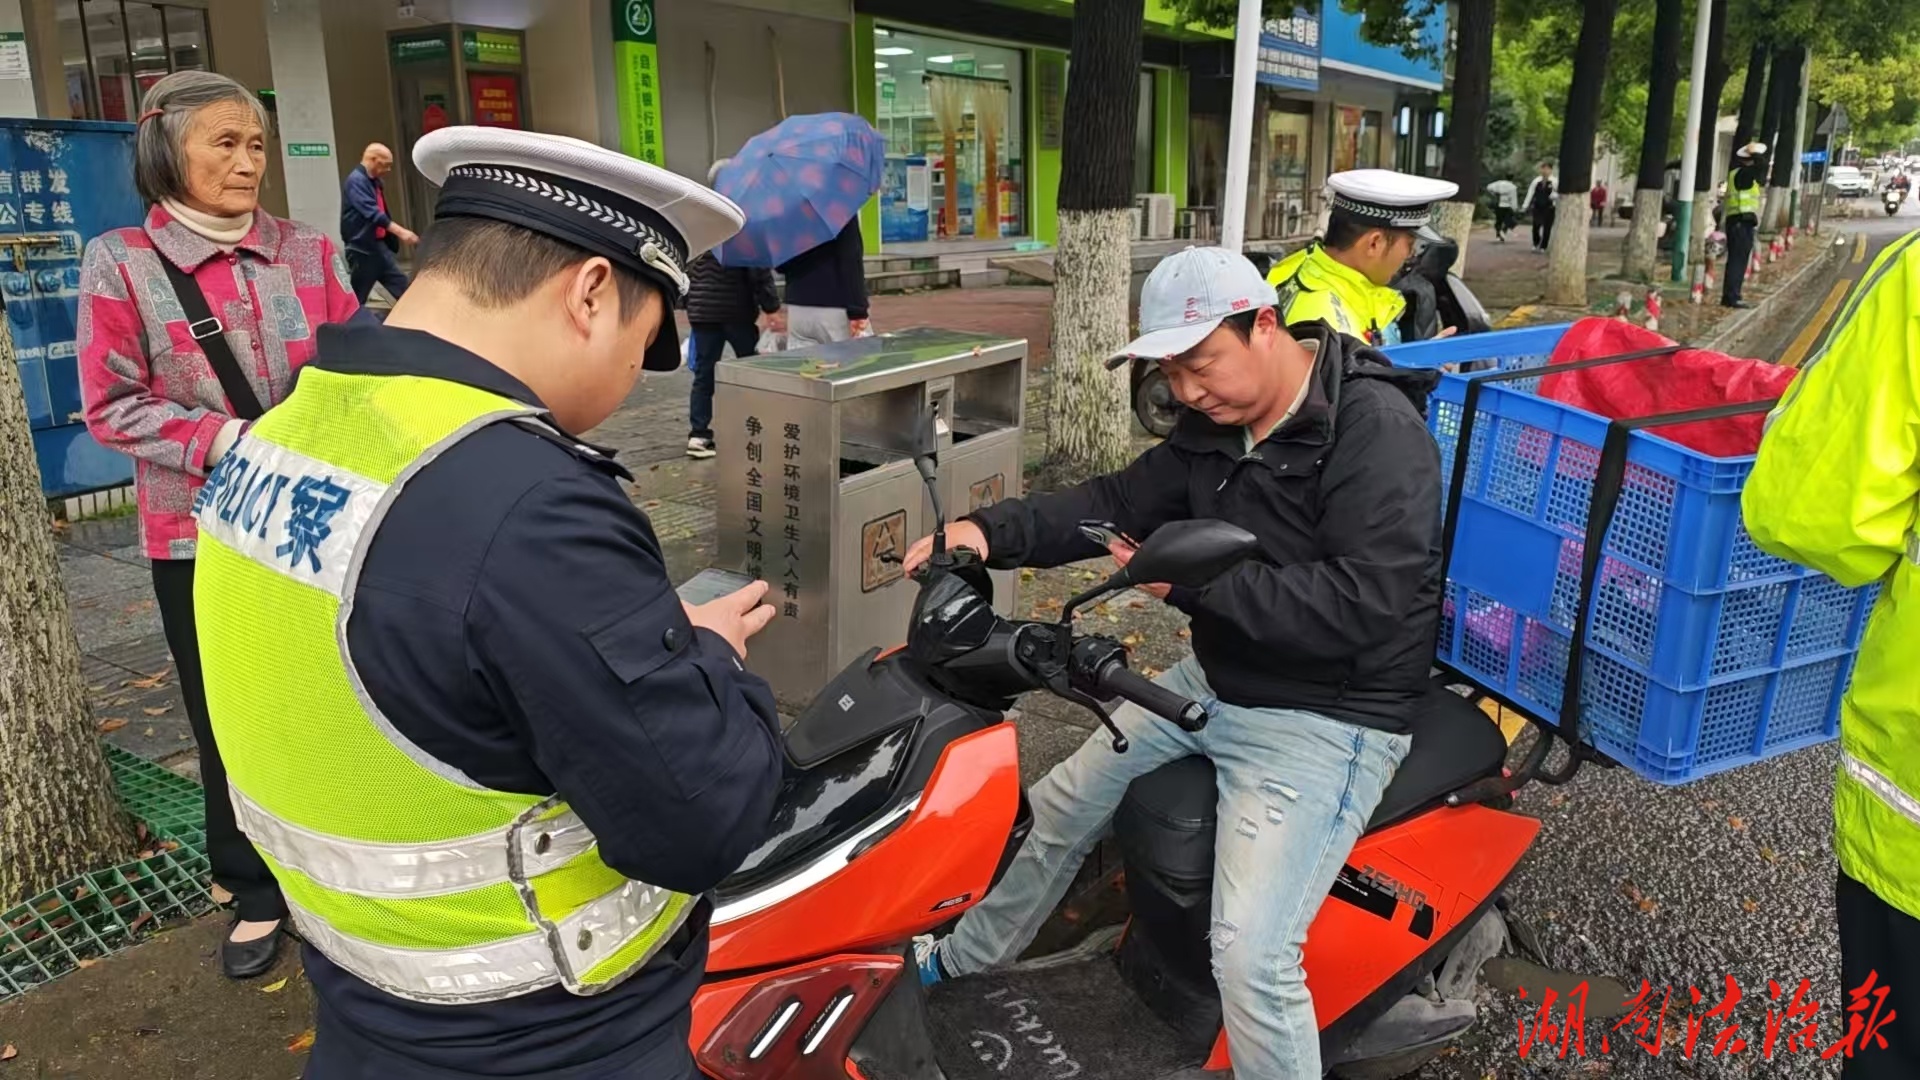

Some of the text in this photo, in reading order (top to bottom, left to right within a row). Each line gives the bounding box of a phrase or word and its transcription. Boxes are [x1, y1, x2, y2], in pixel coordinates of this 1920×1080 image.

[276, 475, 352, 574] 察
[783, 422, 800, 619] 爱护环境卫生人人有责
